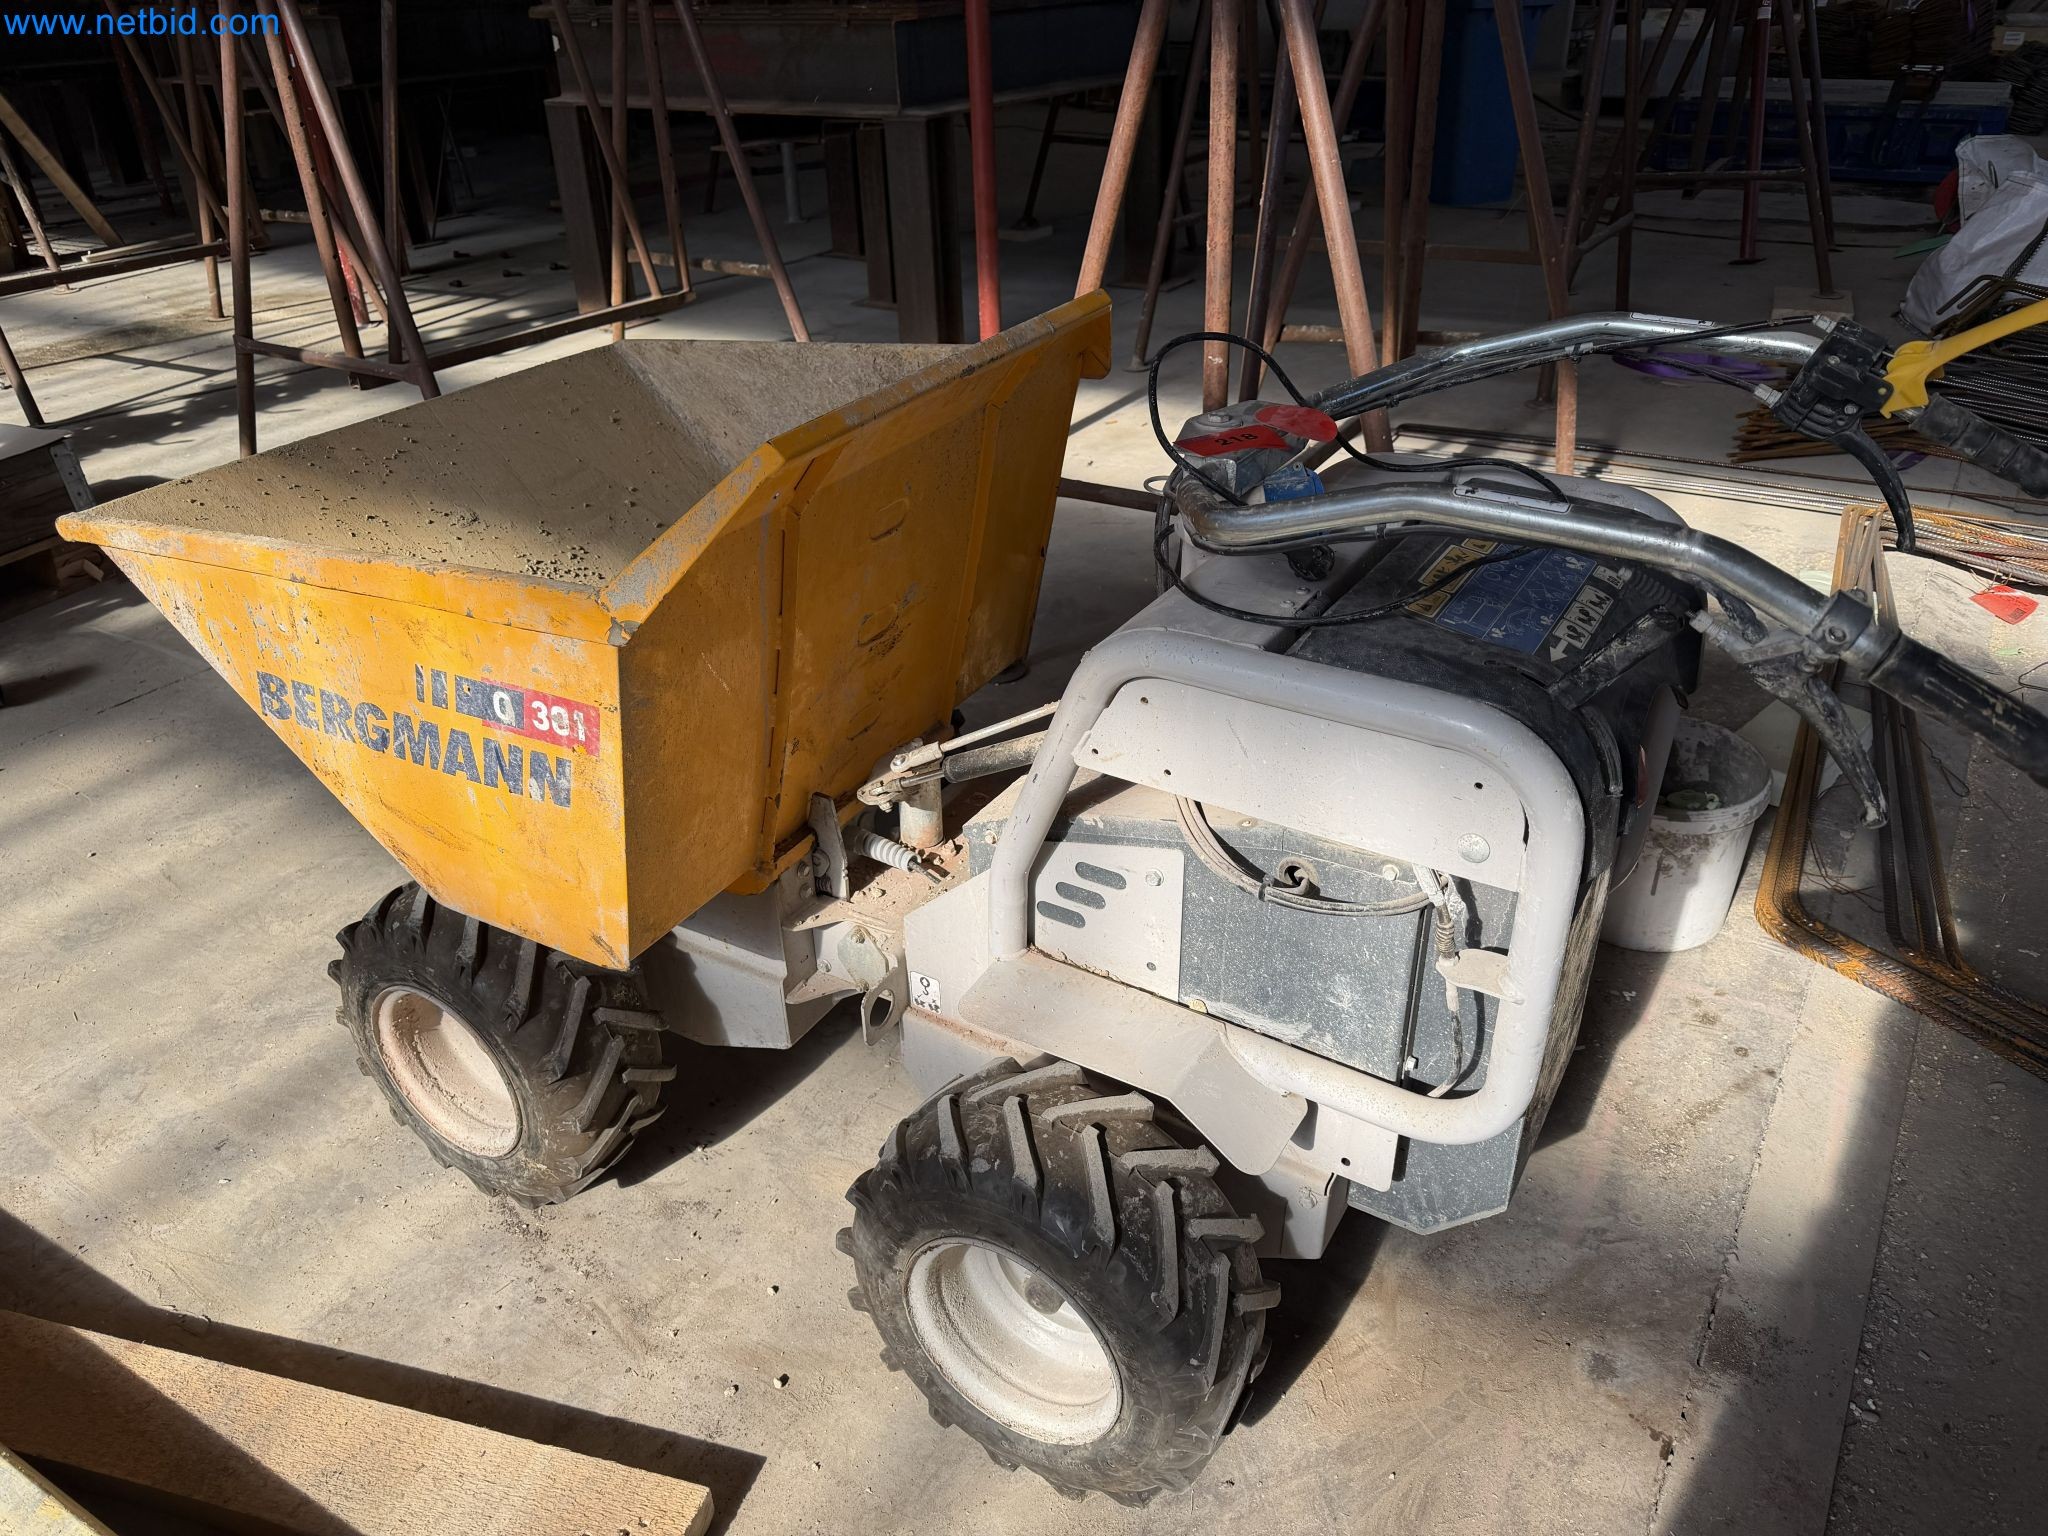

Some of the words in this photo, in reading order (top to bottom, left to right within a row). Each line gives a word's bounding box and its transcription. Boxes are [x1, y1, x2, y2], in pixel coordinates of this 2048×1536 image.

[1215, 433, 1258, 446] 218
[256, 670, 572, 808] BERGMANN
[532, 700, 586, 741] 301
